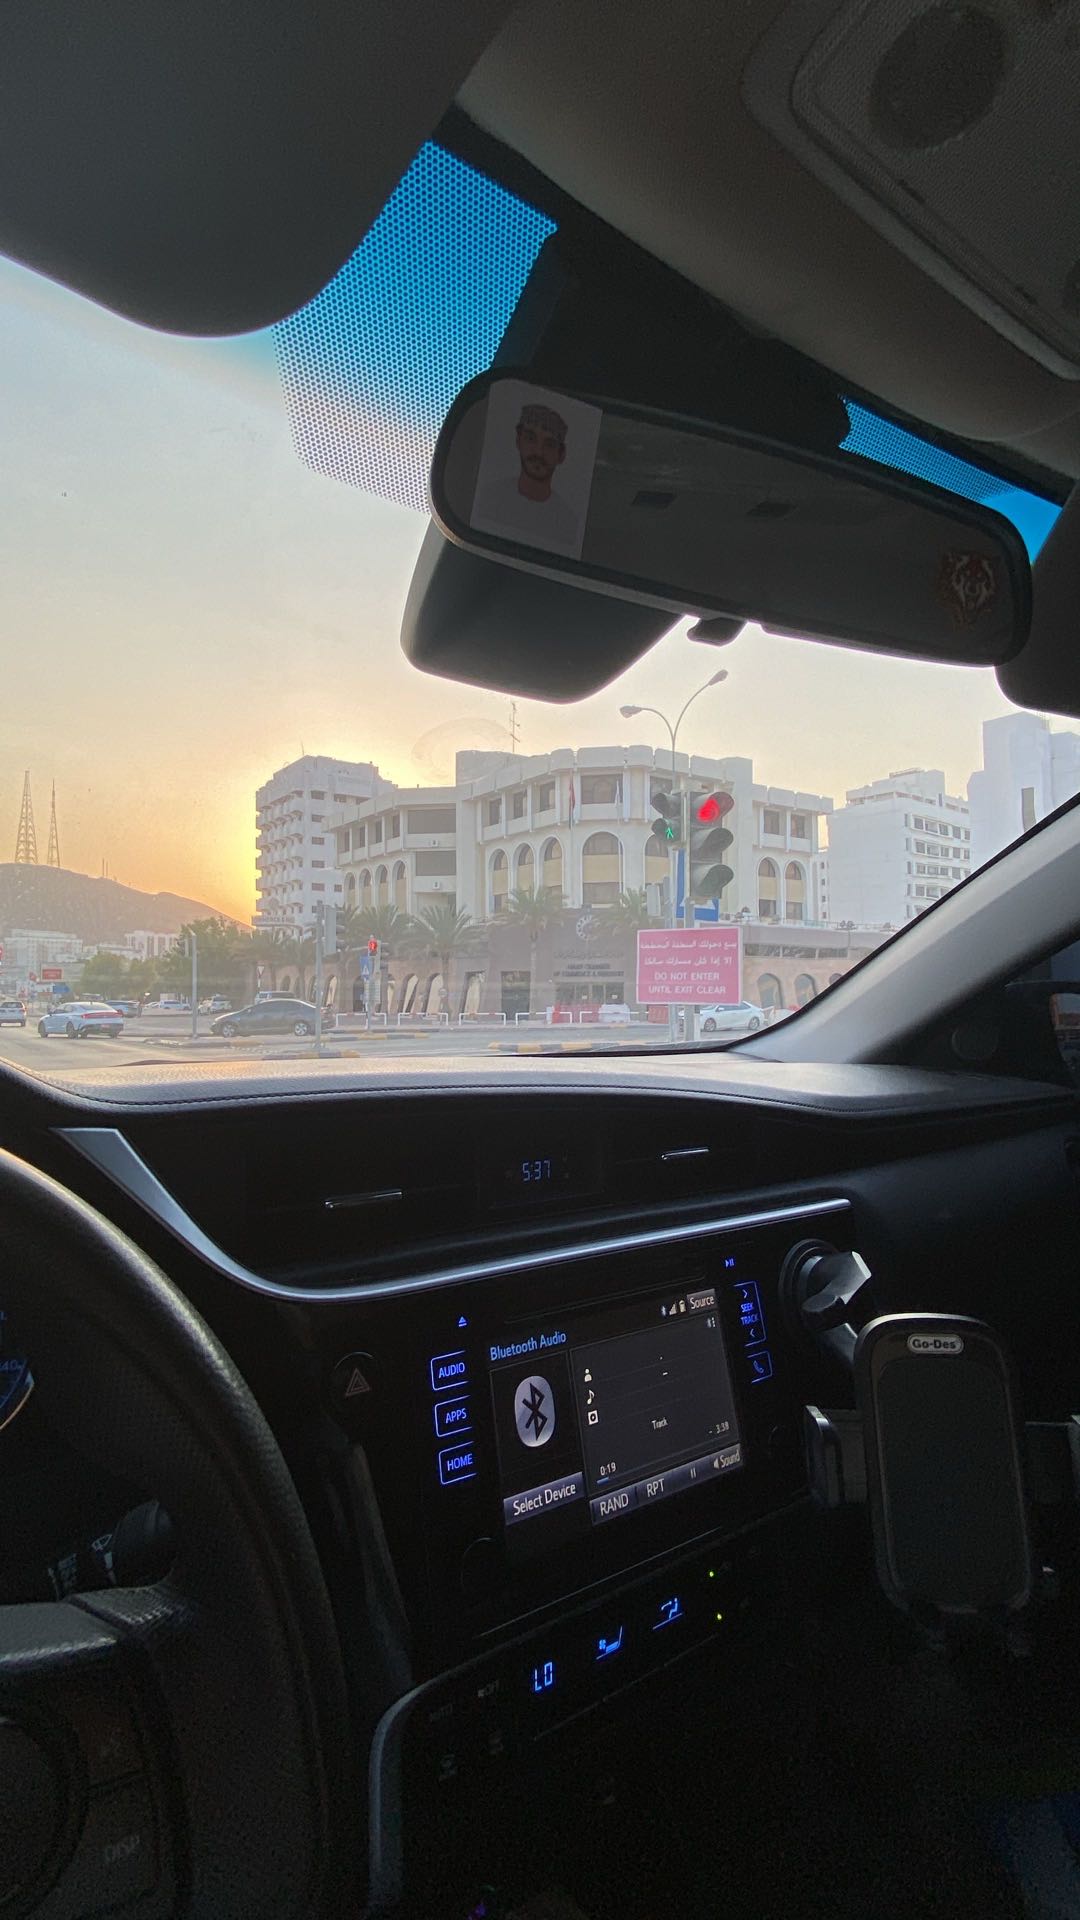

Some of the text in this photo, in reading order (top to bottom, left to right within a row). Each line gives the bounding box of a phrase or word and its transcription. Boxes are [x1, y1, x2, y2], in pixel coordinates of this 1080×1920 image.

[654, 972, 719, 980] DO NOT ENTER
[648, 985, 726, 994] UNTIL EXIT CLEAR
[522, 1160, 550, 1181] 5:37
[689, 1295, 715, 1310] Source
[740, 1302, 754, 1313] SEEK
[740, 1313, 758, 1326] TRACK
[490, 1331, 567, 1361] Bluetooth Audio
[912, 1339, 956, 1349] Go-Des
[438, 1362, 466, 1379] AUDIO
[445, 1408, 467, 1424] APPS
[447, 1453, 473, 1471] HOME
[720, 1450, 741, 1468] Sound
[600, 1462, 616, 1476] 0:19
[646, 1479, 665, 1497] RPT
[513, 1483, 576, 1516] Select Device
[600, 1493, 629, 1516] RAND
